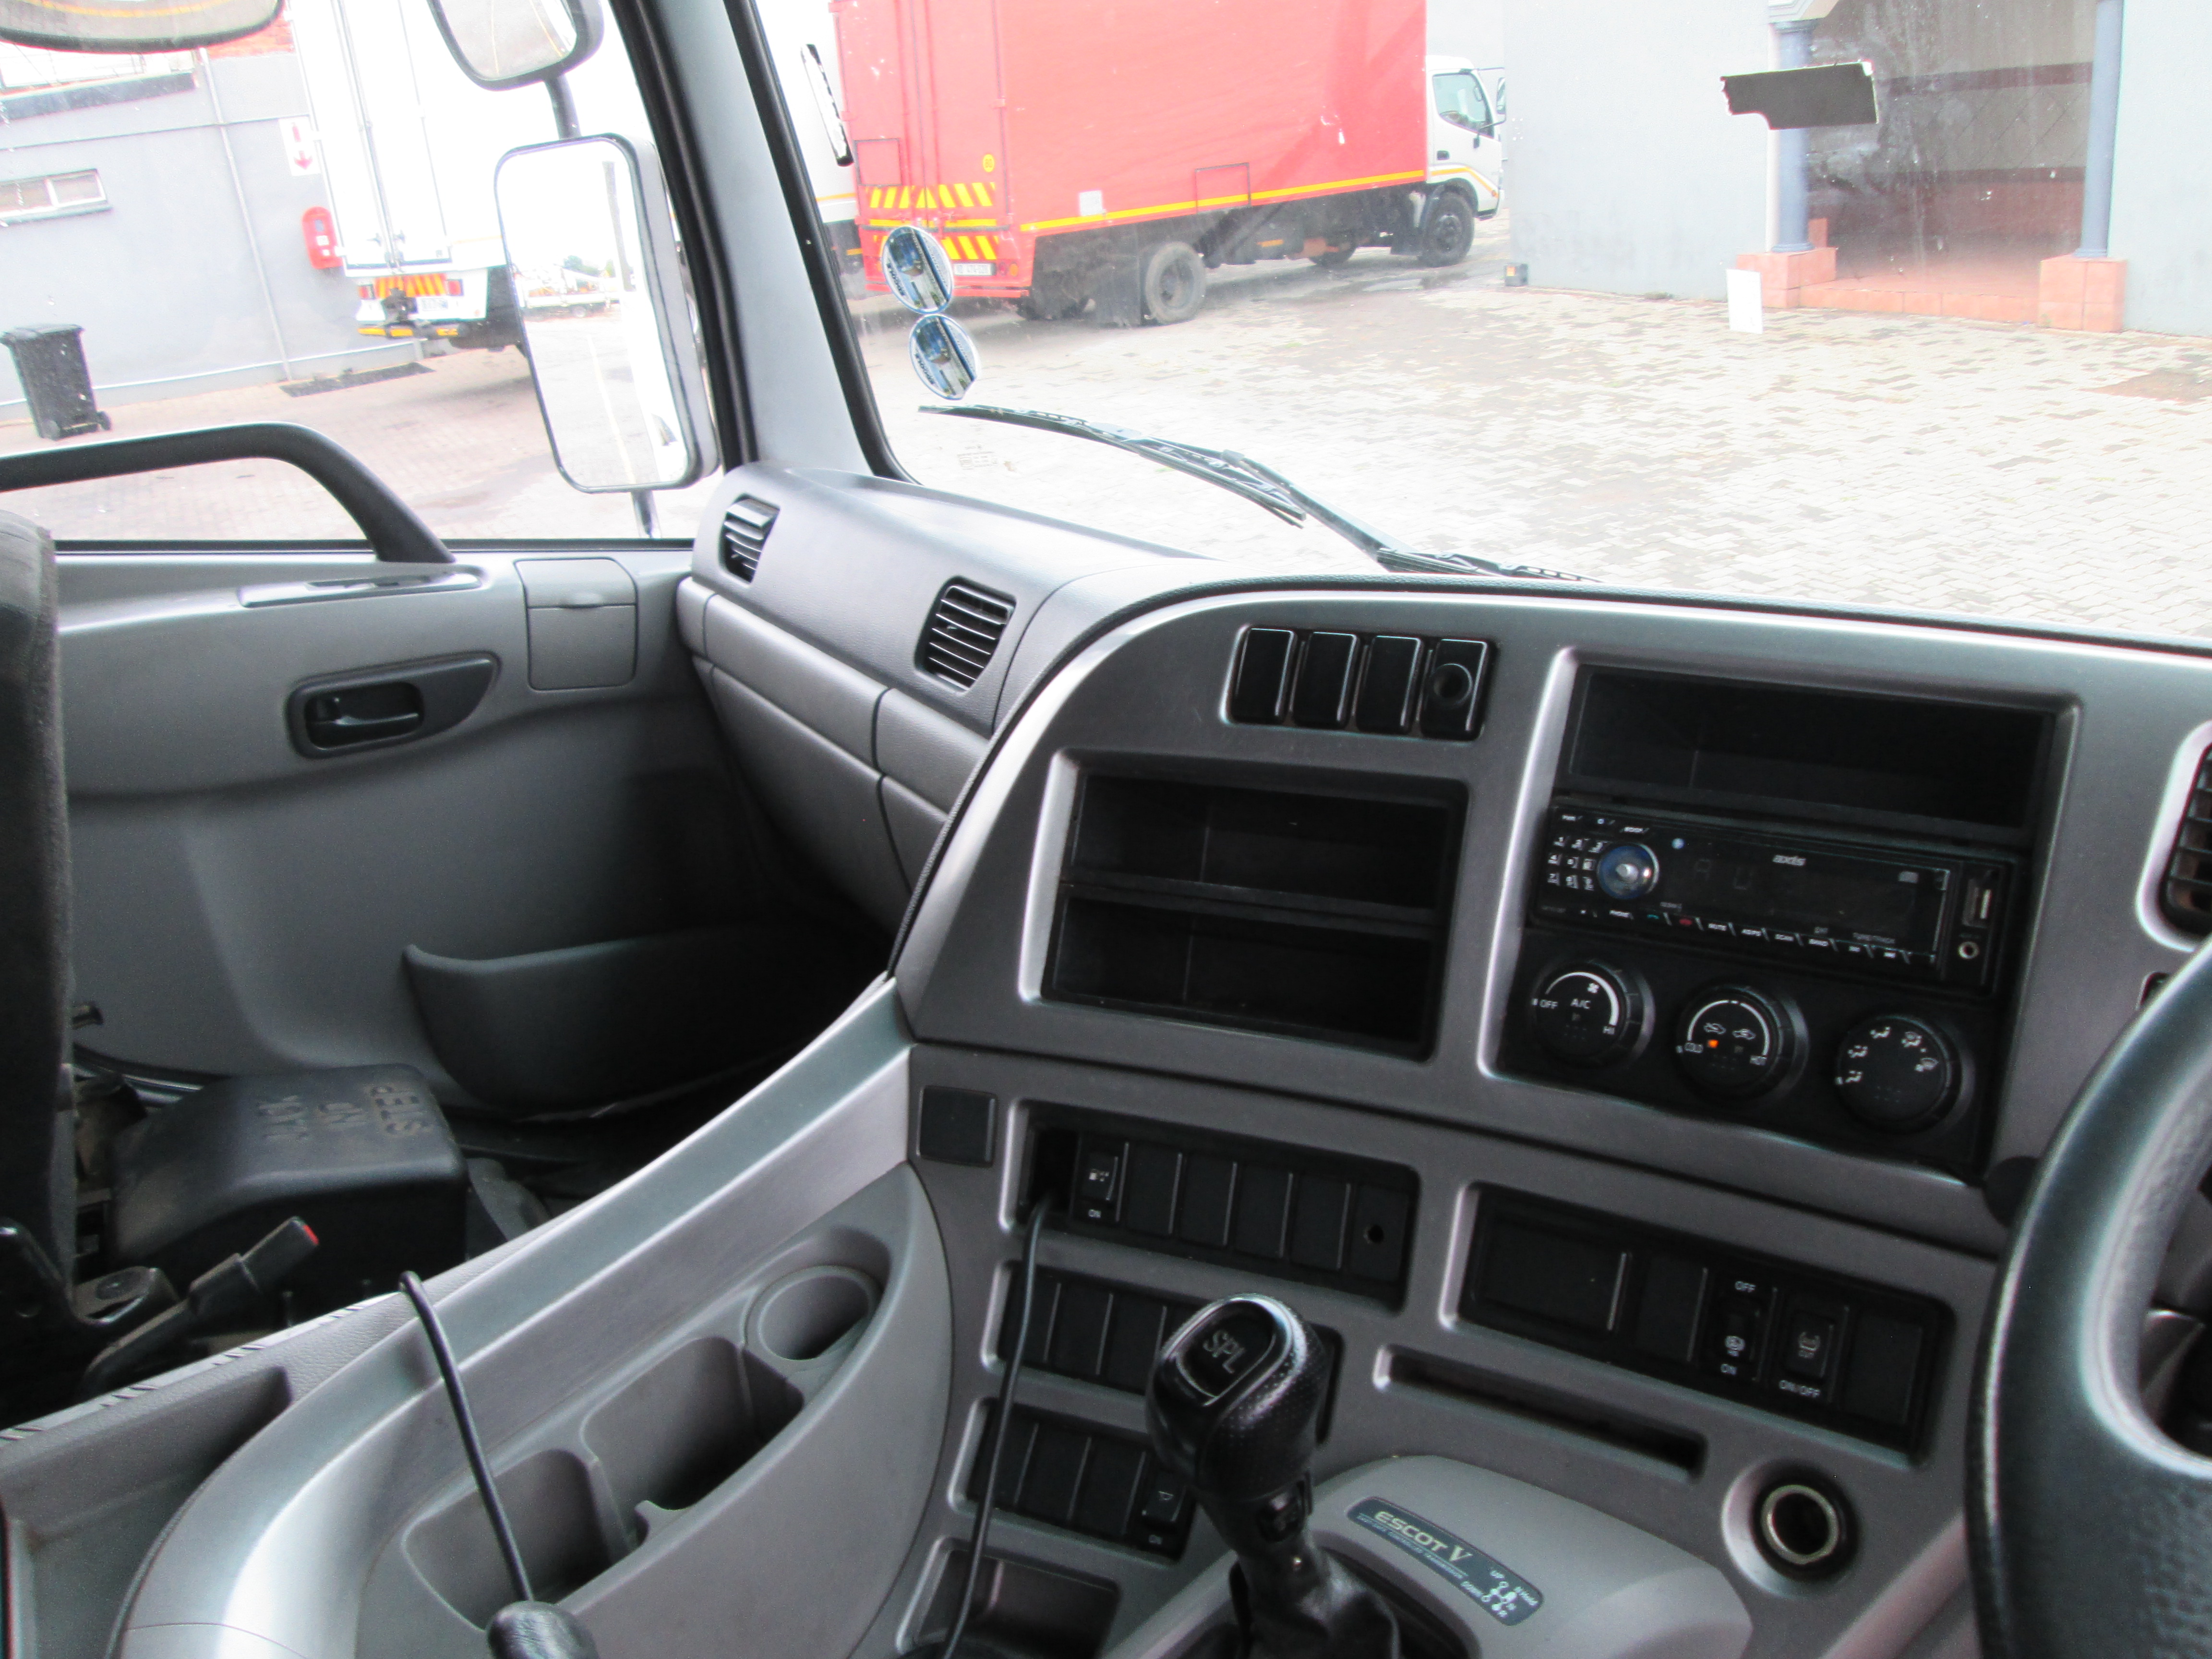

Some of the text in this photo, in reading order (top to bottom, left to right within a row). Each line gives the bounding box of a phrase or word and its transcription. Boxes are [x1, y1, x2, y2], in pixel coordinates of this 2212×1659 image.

[1539, 999, 1559, 1009] OFF
[1570, 998, 1591, 1009] A/C
[1684, 1042, 1704, 1053] COLD
[1088, 1209, 1102, 1219] ON
[1734, 1281, 1756, 1293] OFF
[1202, 1330, 1247, 1374] SPL
[1720, 1363, 1737, 1376] ON
[1779, 1380, 1821, 1398] ON/OFF
[1374, 1511, 1449, 1552] ESCOT
[1449, 1544, 1473, 1561] V
